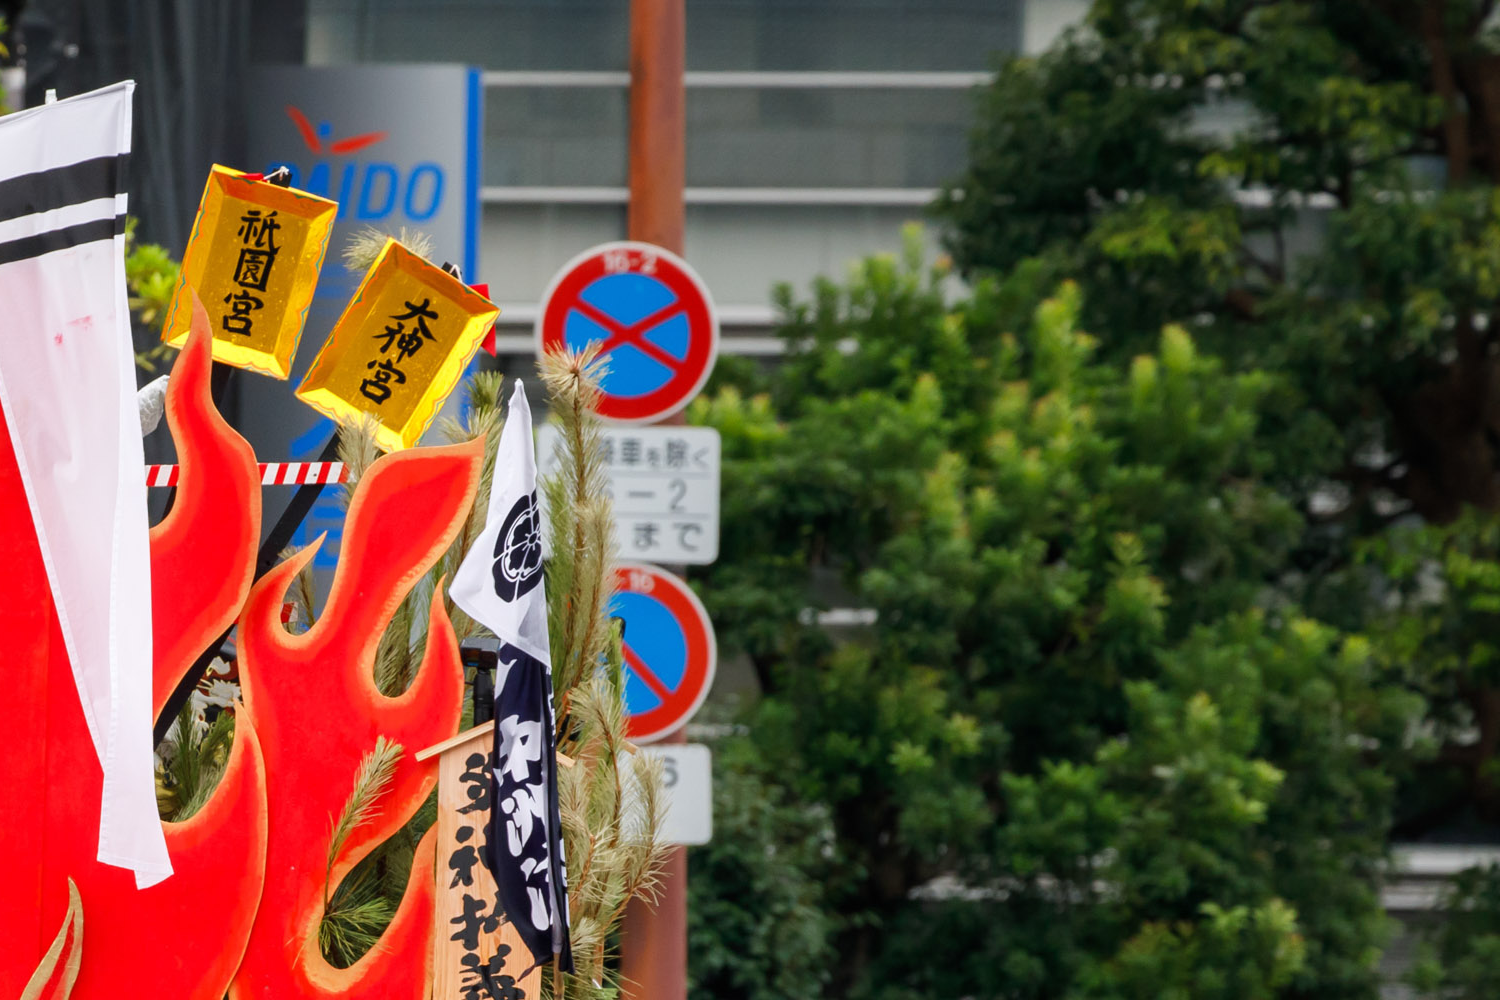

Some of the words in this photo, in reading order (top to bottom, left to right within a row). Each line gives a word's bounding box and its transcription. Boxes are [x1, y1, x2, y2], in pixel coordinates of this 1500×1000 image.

[222, 209, 282, 337] 祇園宮
[359, 297, 440, 405] 大神宮
